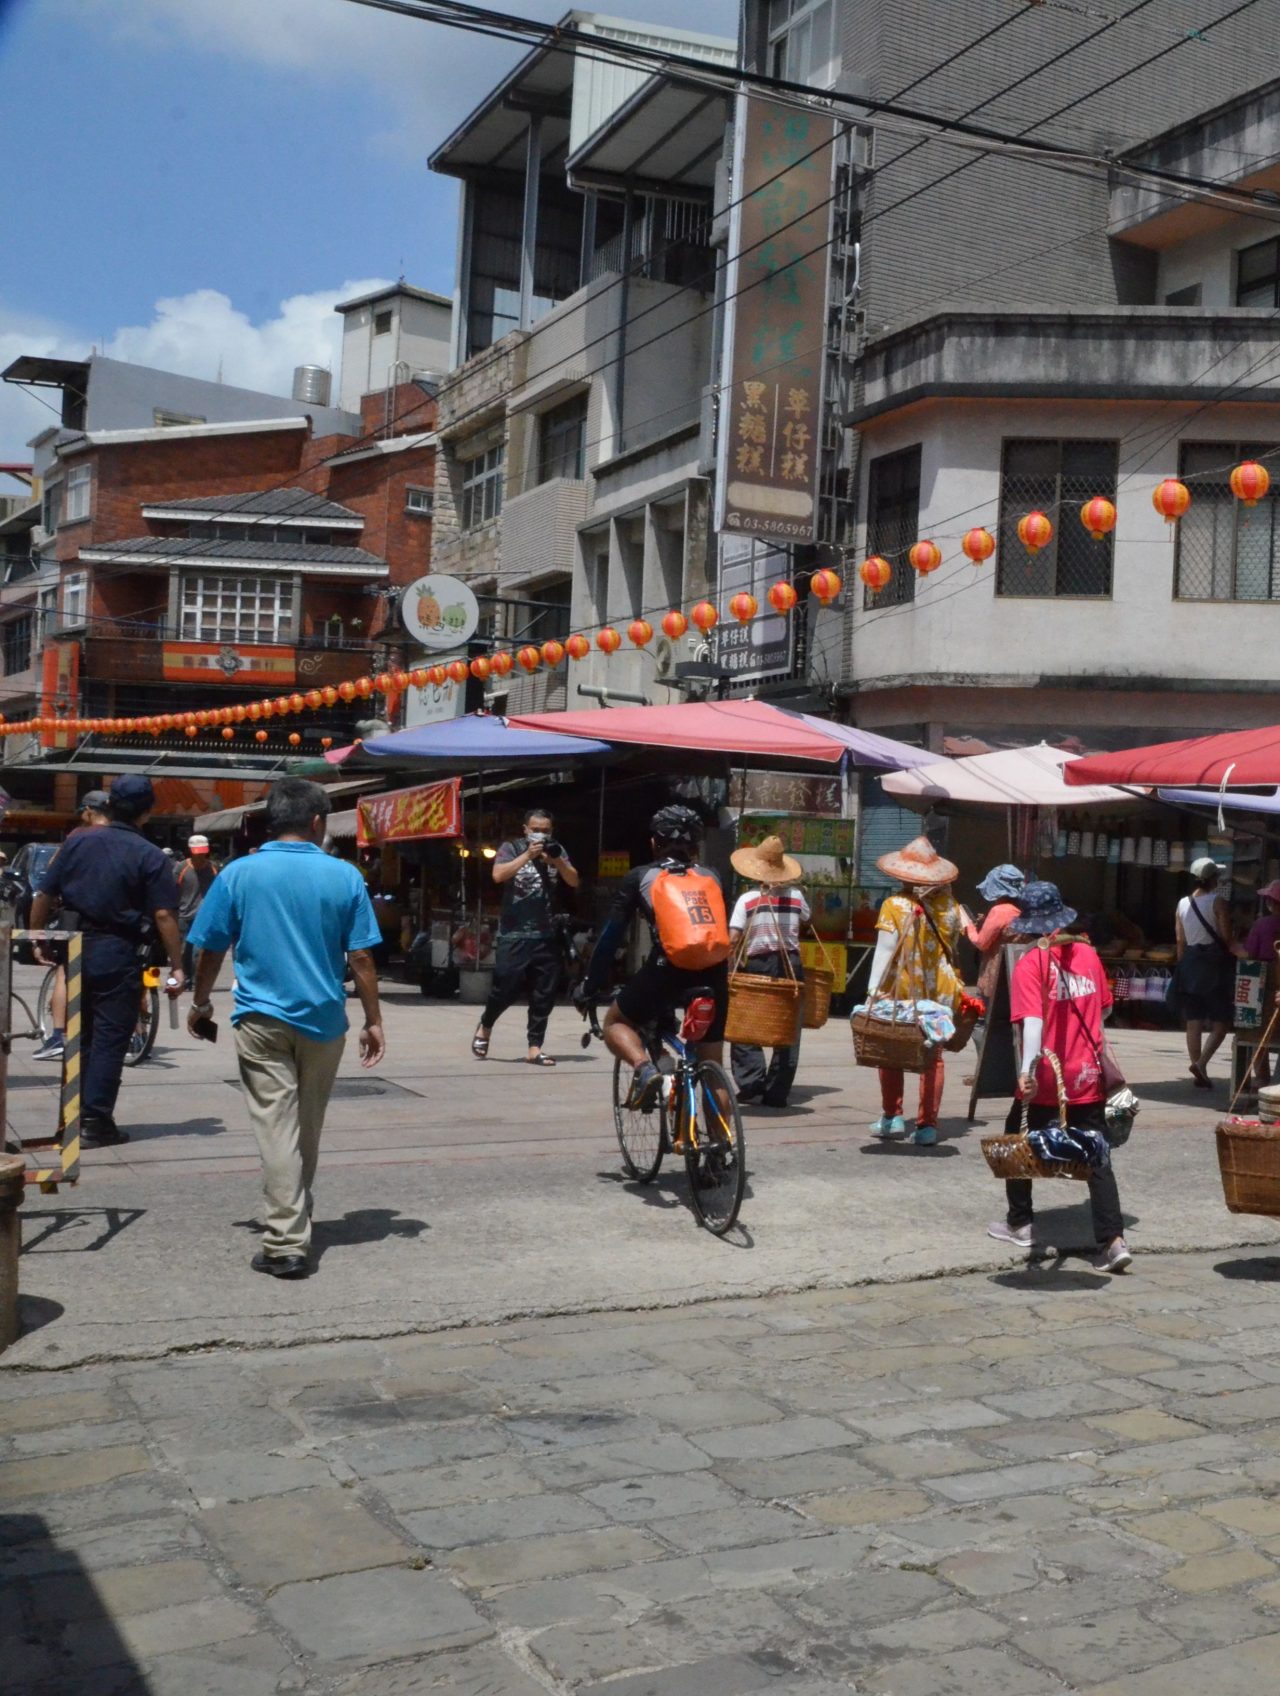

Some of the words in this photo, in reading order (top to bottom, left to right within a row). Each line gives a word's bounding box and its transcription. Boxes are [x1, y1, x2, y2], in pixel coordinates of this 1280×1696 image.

[735, 380, 768, 477] 黑糖糕
[743, 517, 813, 537] 03-5805967
[690, 907, 713, 923] 15
